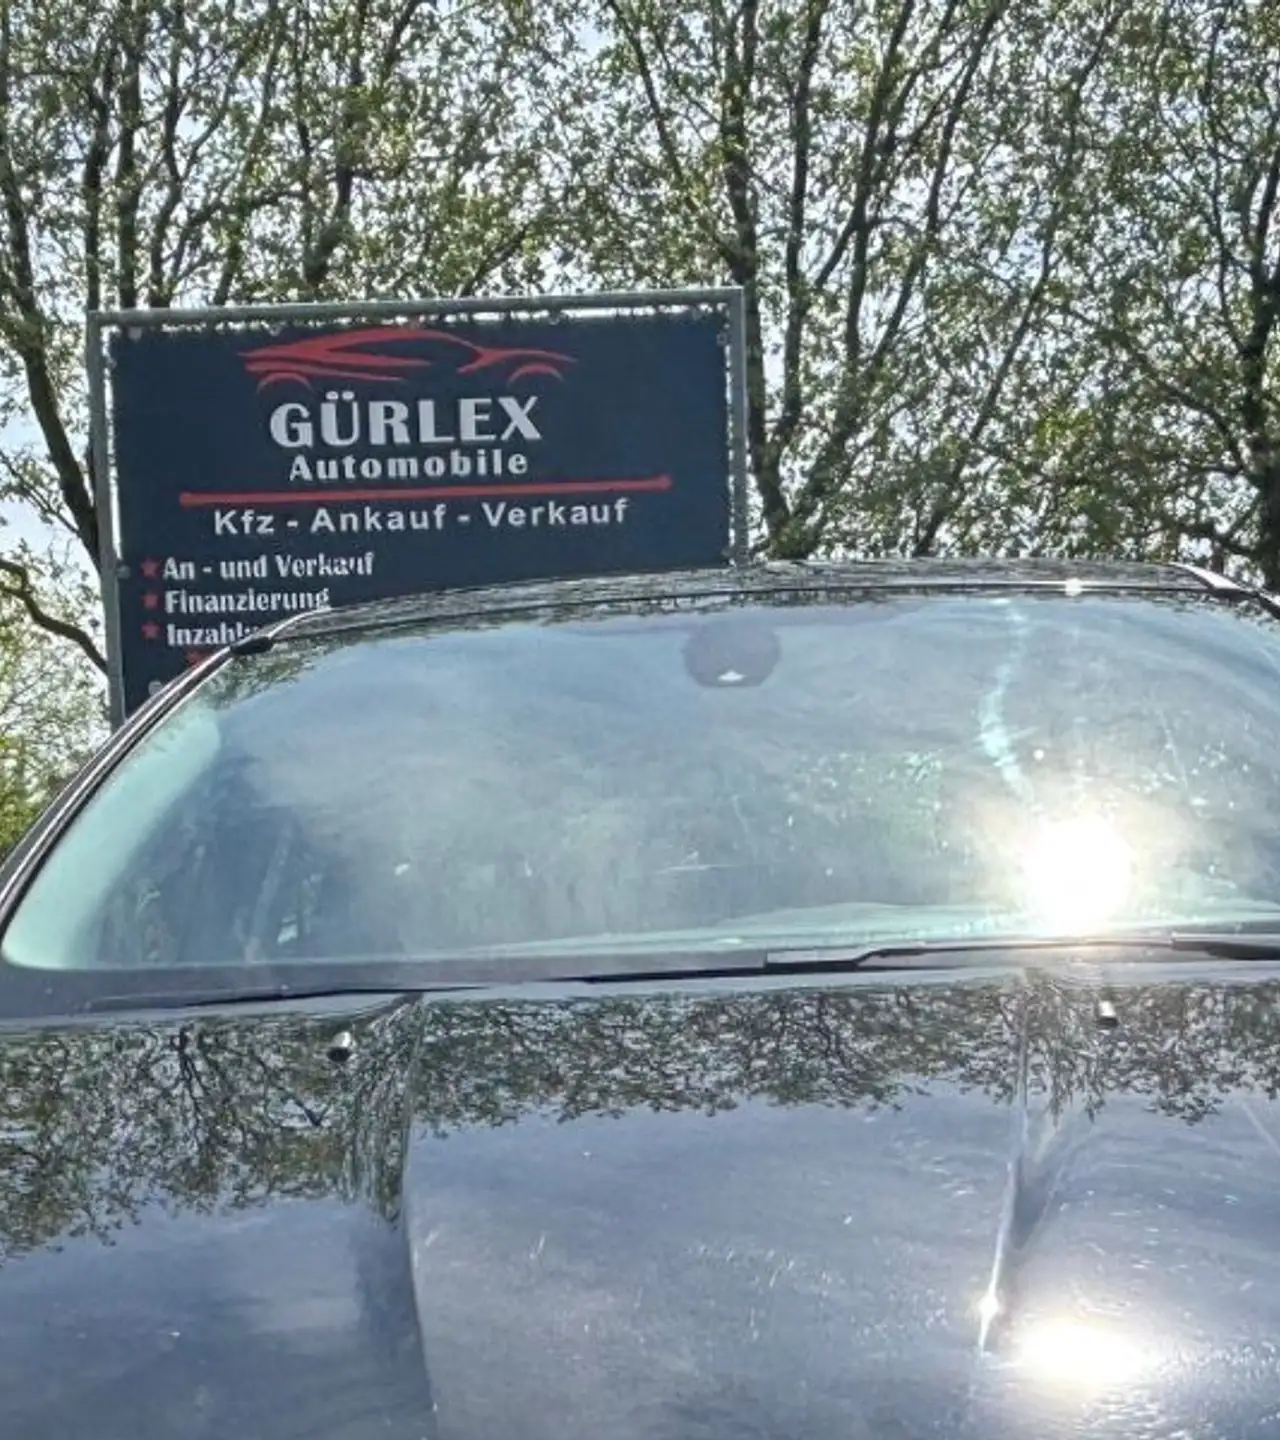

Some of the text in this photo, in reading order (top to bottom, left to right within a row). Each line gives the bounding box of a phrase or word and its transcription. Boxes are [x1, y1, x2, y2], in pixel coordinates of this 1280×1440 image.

[269, 391, 543, 448] GÜRLEX
[289, 449, 529, 481] Automobile
[214, 509, 276, 535] Kfz
[309, 503, 447, 533] Ankauf
[481, 498, 628, 528] Verkauf
[219, 555, 268, 579] und
[275, 552, 375, 578] Verkauf
[164, 588, 330, 613] Finanzierung
[167, 621, 258, 646] Inzahl
